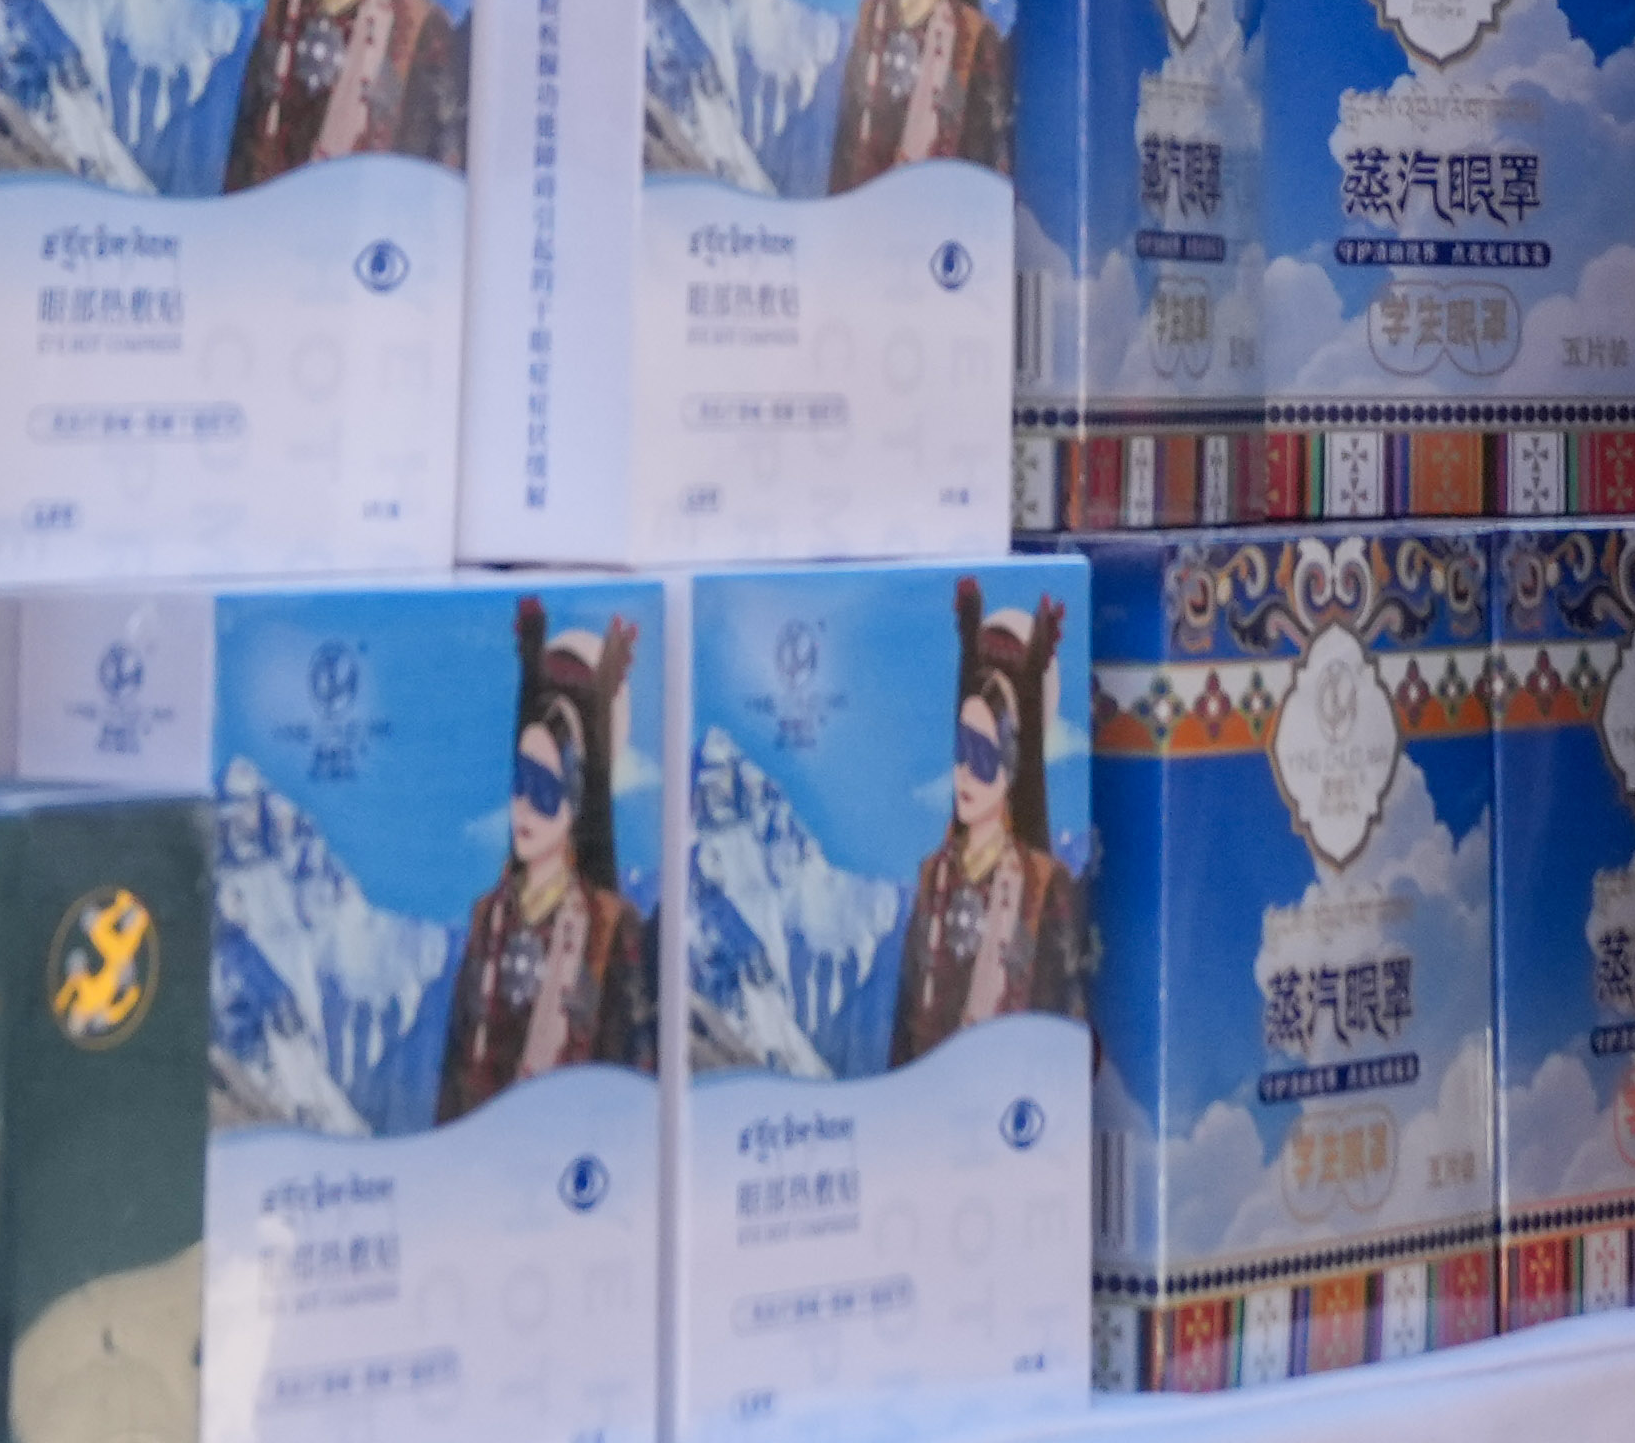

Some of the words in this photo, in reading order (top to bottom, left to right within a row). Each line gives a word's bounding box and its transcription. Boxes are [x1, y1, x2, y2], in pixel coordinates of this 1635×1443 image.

[1342, 145, 1542, 227] 蒸汽眼罩
[1266, 955, 1414, 1053] 蒸汽眼罩
